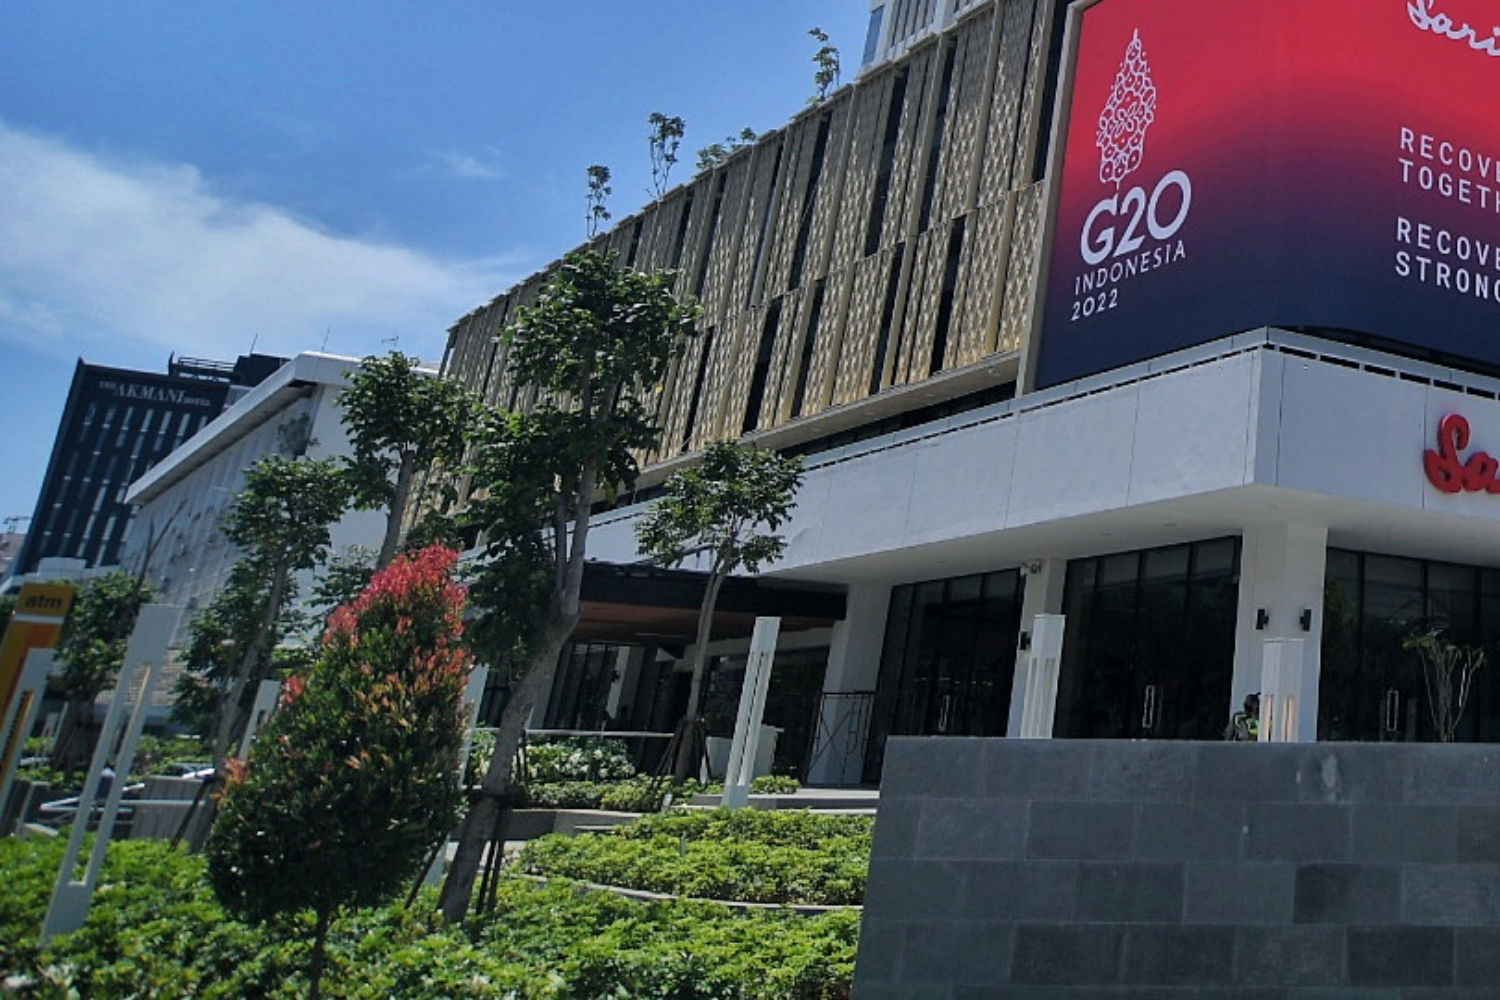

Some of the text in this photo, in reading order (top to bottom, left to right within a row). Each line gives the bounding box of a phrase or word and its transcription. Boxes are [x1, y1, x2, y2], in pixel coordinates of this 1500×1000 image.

[1080, 170, 1192, 265] G20
[1074, 239, 1186, 296] INDONESIA
[1070, 288, 1118, 322] 2022
[114, 383, 186, 403] AKMANI
[25, 594, 63, 609] atm
